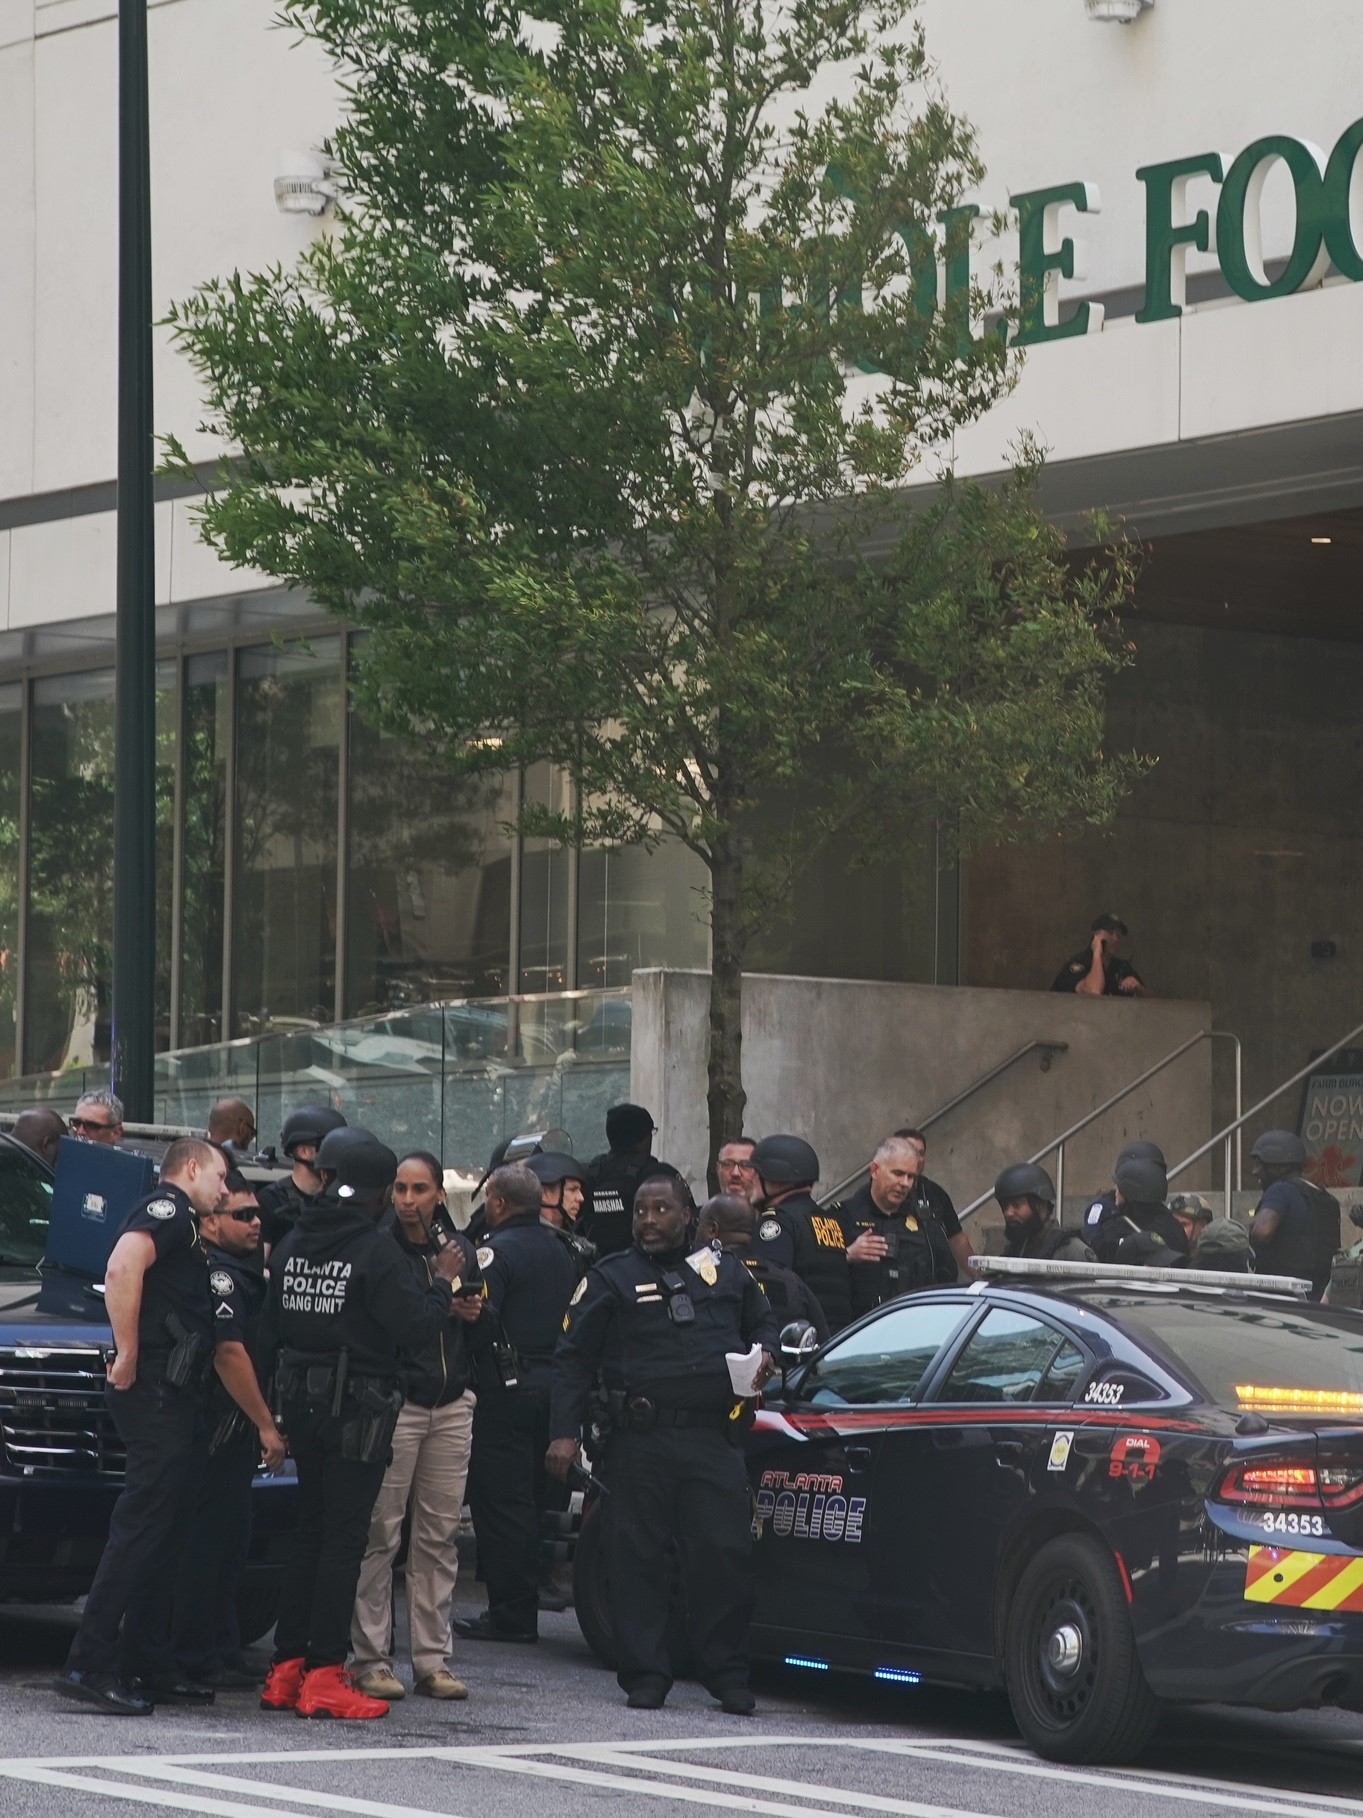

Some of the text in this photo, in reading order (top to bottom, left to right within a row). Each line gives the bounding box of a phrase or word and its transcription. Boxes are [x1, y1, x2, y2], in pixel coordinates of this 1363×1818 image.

[593, 1198, 624, 1213] MARSHAL
[811, 1216, 842, 1232] ATLANTA
[815, 1228, 845, 1249] POLICE
[283, 1275, 347, 1297] POLICE
[282, 1294, 345, 1314] GANG UNIT
[1084, 1381, 1125, 1405] 34353
[1125, 1438, 1150, 1449] DIAL
[1109, 1460, 1156, 1480] 9-1-1
[760, 1470, 843, 1494] ATLANTA
[751, 1489, 867, 1543] POLICE
[1262, 1512, 1323, 1537] 34353
